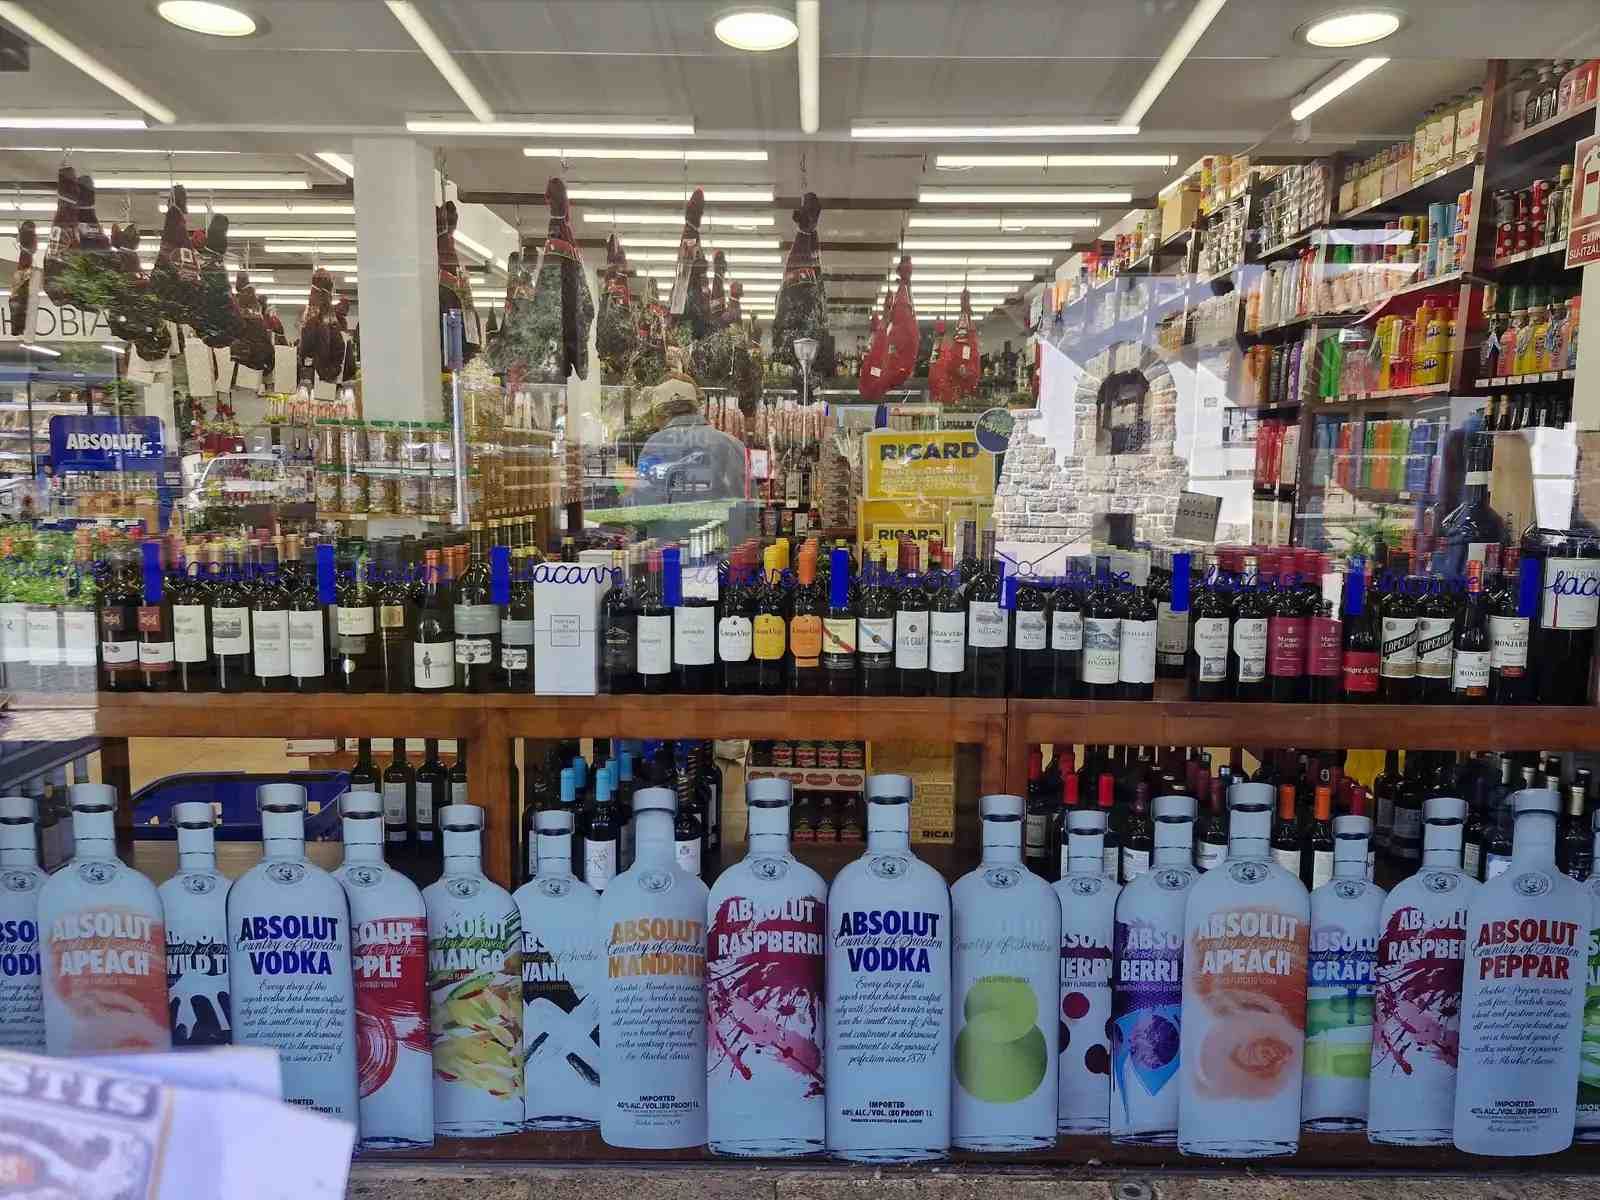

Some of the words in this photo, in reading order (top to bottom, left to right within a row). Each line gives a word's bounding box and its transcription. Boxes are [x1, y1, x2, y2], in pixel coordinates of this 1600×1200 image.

[66, 433, 143, 450] ABSOLUT
[880, 441, 979, 461] RICARD
[52, 911, 152, 944] ABSOLUT
[240, 915, 338, 941] ABSOLUT
[611, 918, 703, 945] ABSOLUT
[840, 911, 939, 937] ABSOLUT
[1199, 912, 1298, 941] ABSOLUT
[1479, 918, 1578, 947] ABSOLUT
[718, 930, 823, 957] RASPBERRI
[834, 930, 880, 949] Country
[883, 934, 900, 951] of
[60, 950, 150, 977] APEACH
[249, 951, 332, 975] VODKA
[848, 947, 931, 972] VODKA
[1121, 959, 1179, 981] BERRI
[1202, 949, 1291, 976] APEACH
[1480, 954, 1570, 980] PEPPAR
[639, 1095, 676, 1103] IMPORTED
[869, 1101, 905, 1109] IMPORTED
